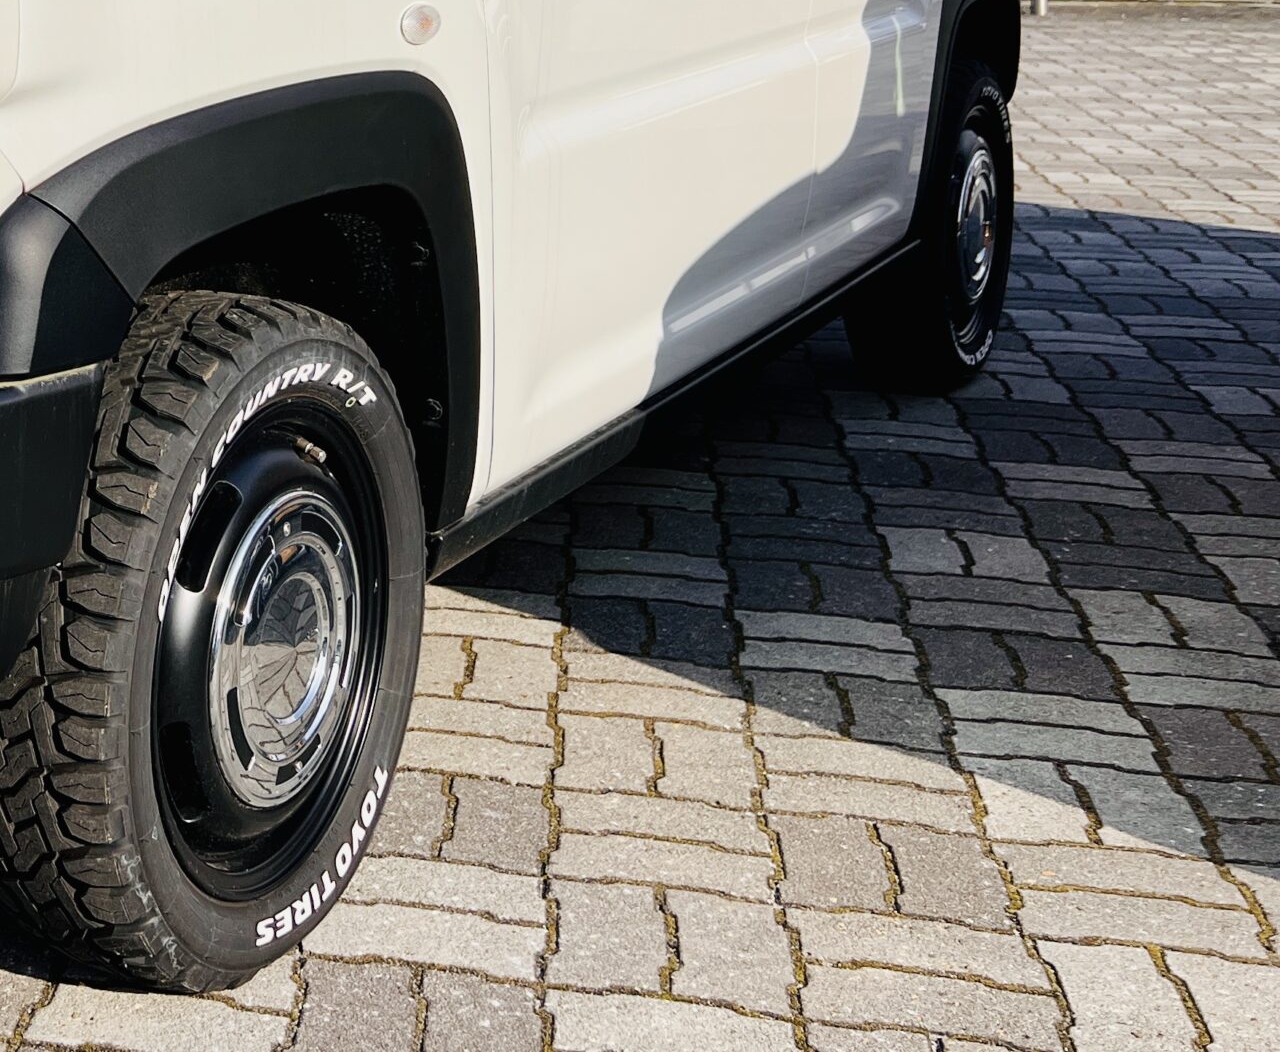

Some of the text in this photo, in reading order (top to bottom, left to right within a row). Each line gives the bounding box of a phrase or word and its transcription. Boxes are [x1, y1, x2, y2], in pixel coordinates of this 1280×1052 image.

[211, 363, 330, 468] COUNTRY
[331, 367, 378, 408] R/T
[255, 765, 389, 947] TOYO TIRES
